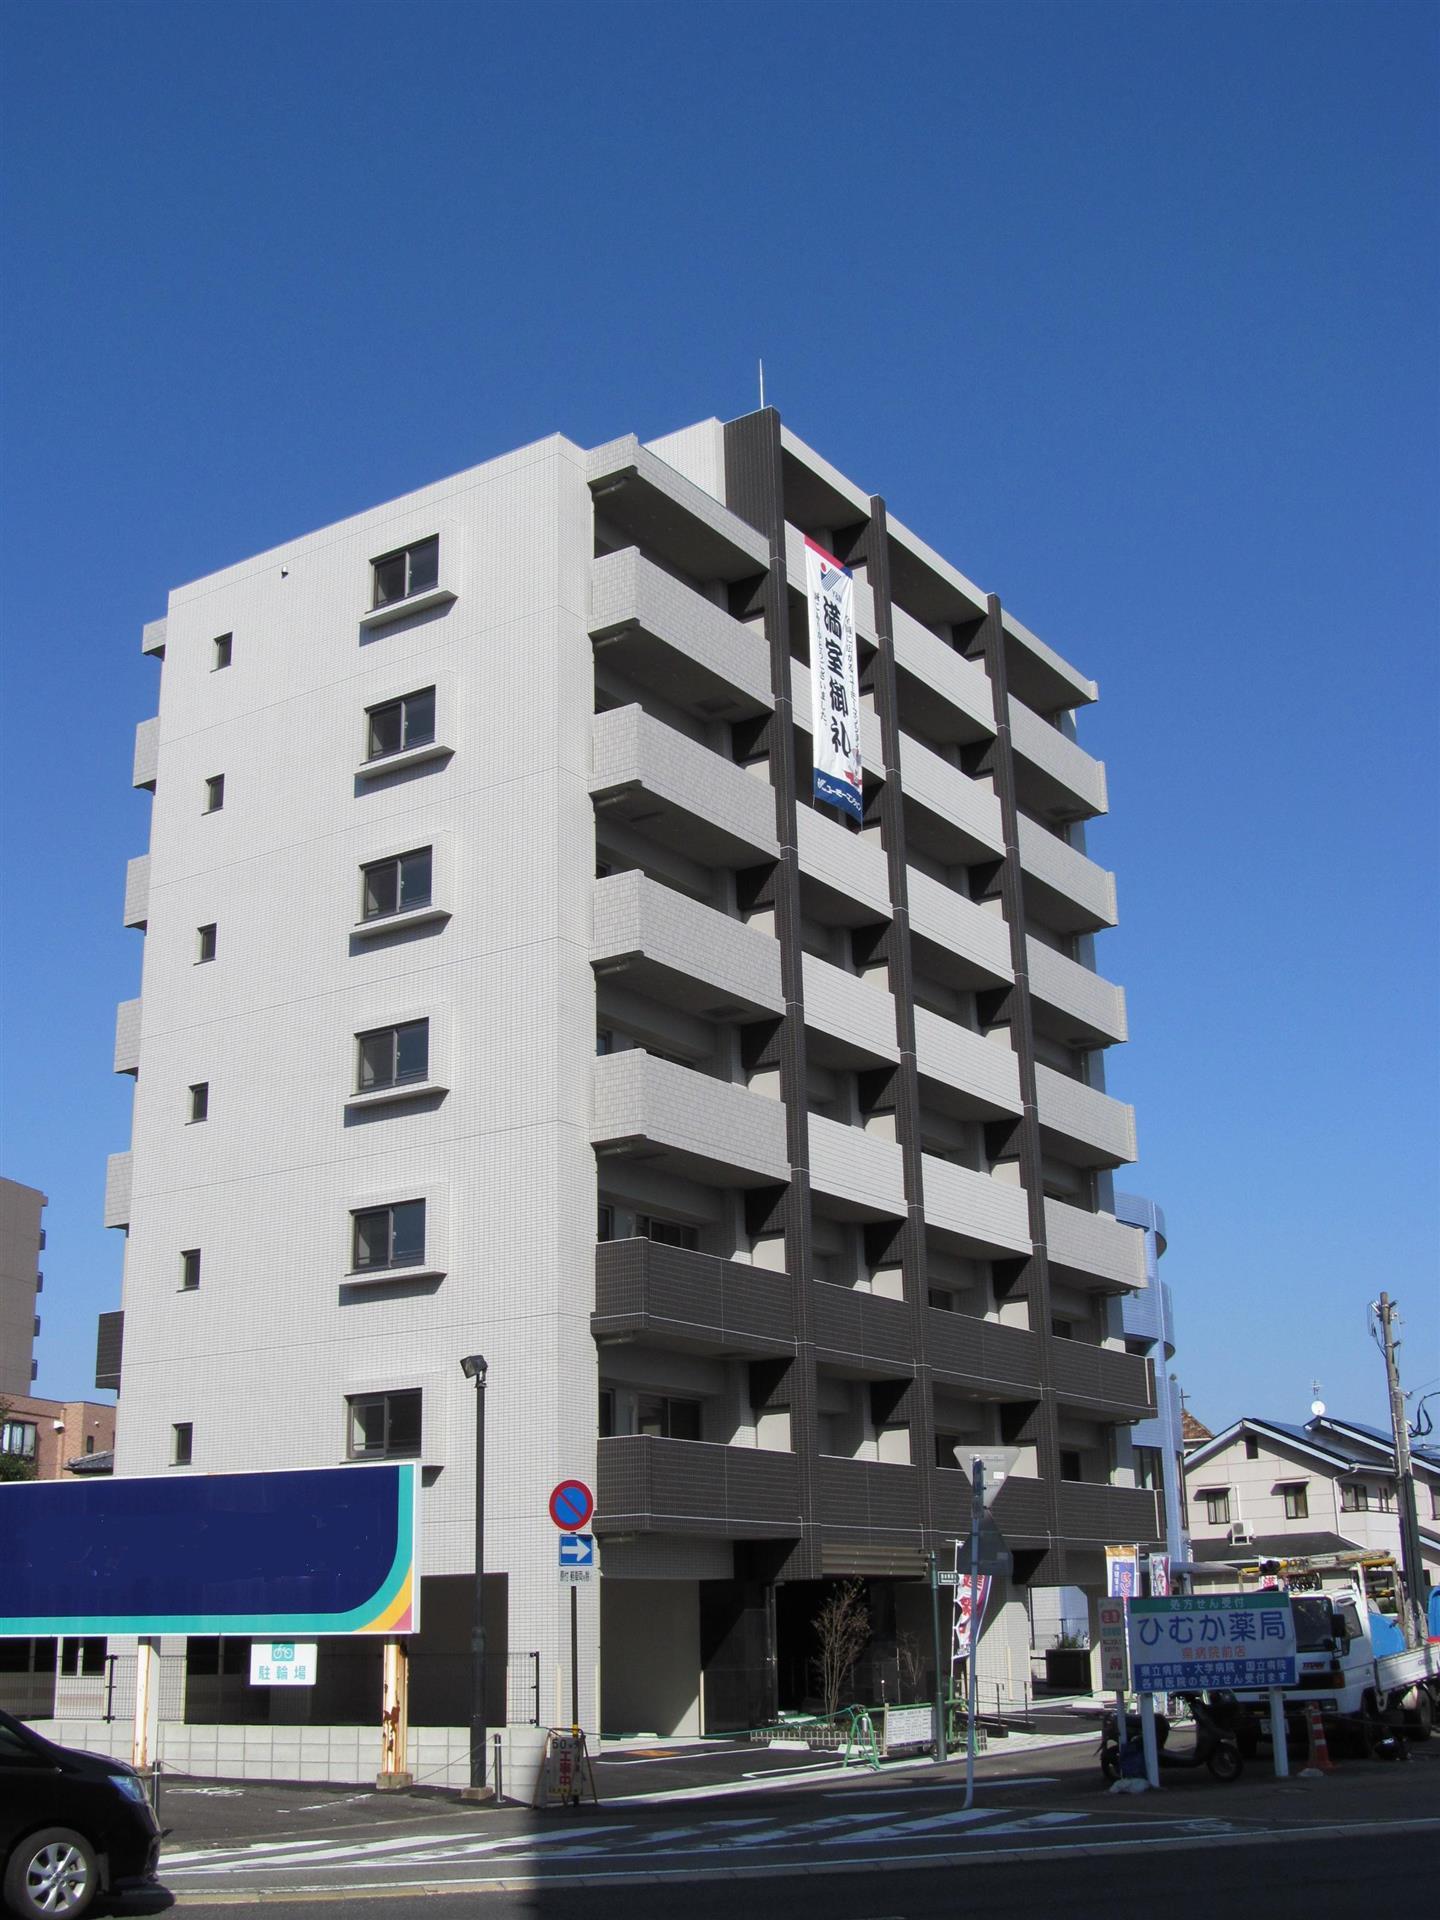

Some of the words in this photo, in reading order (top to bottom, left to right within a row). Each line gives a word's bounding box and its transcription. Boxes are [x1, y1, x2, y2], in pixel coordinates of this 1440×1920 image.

[823, 595, 851, 758] 満室御礼
[1170, 1597, 1245, 1609] 処方せん受付
[1137, 1611, 1286, 1646] ひむか薬局
[259, 1665, 306, 1680] 駐輪場
[560, 1751, 571, 1786] 工事中
